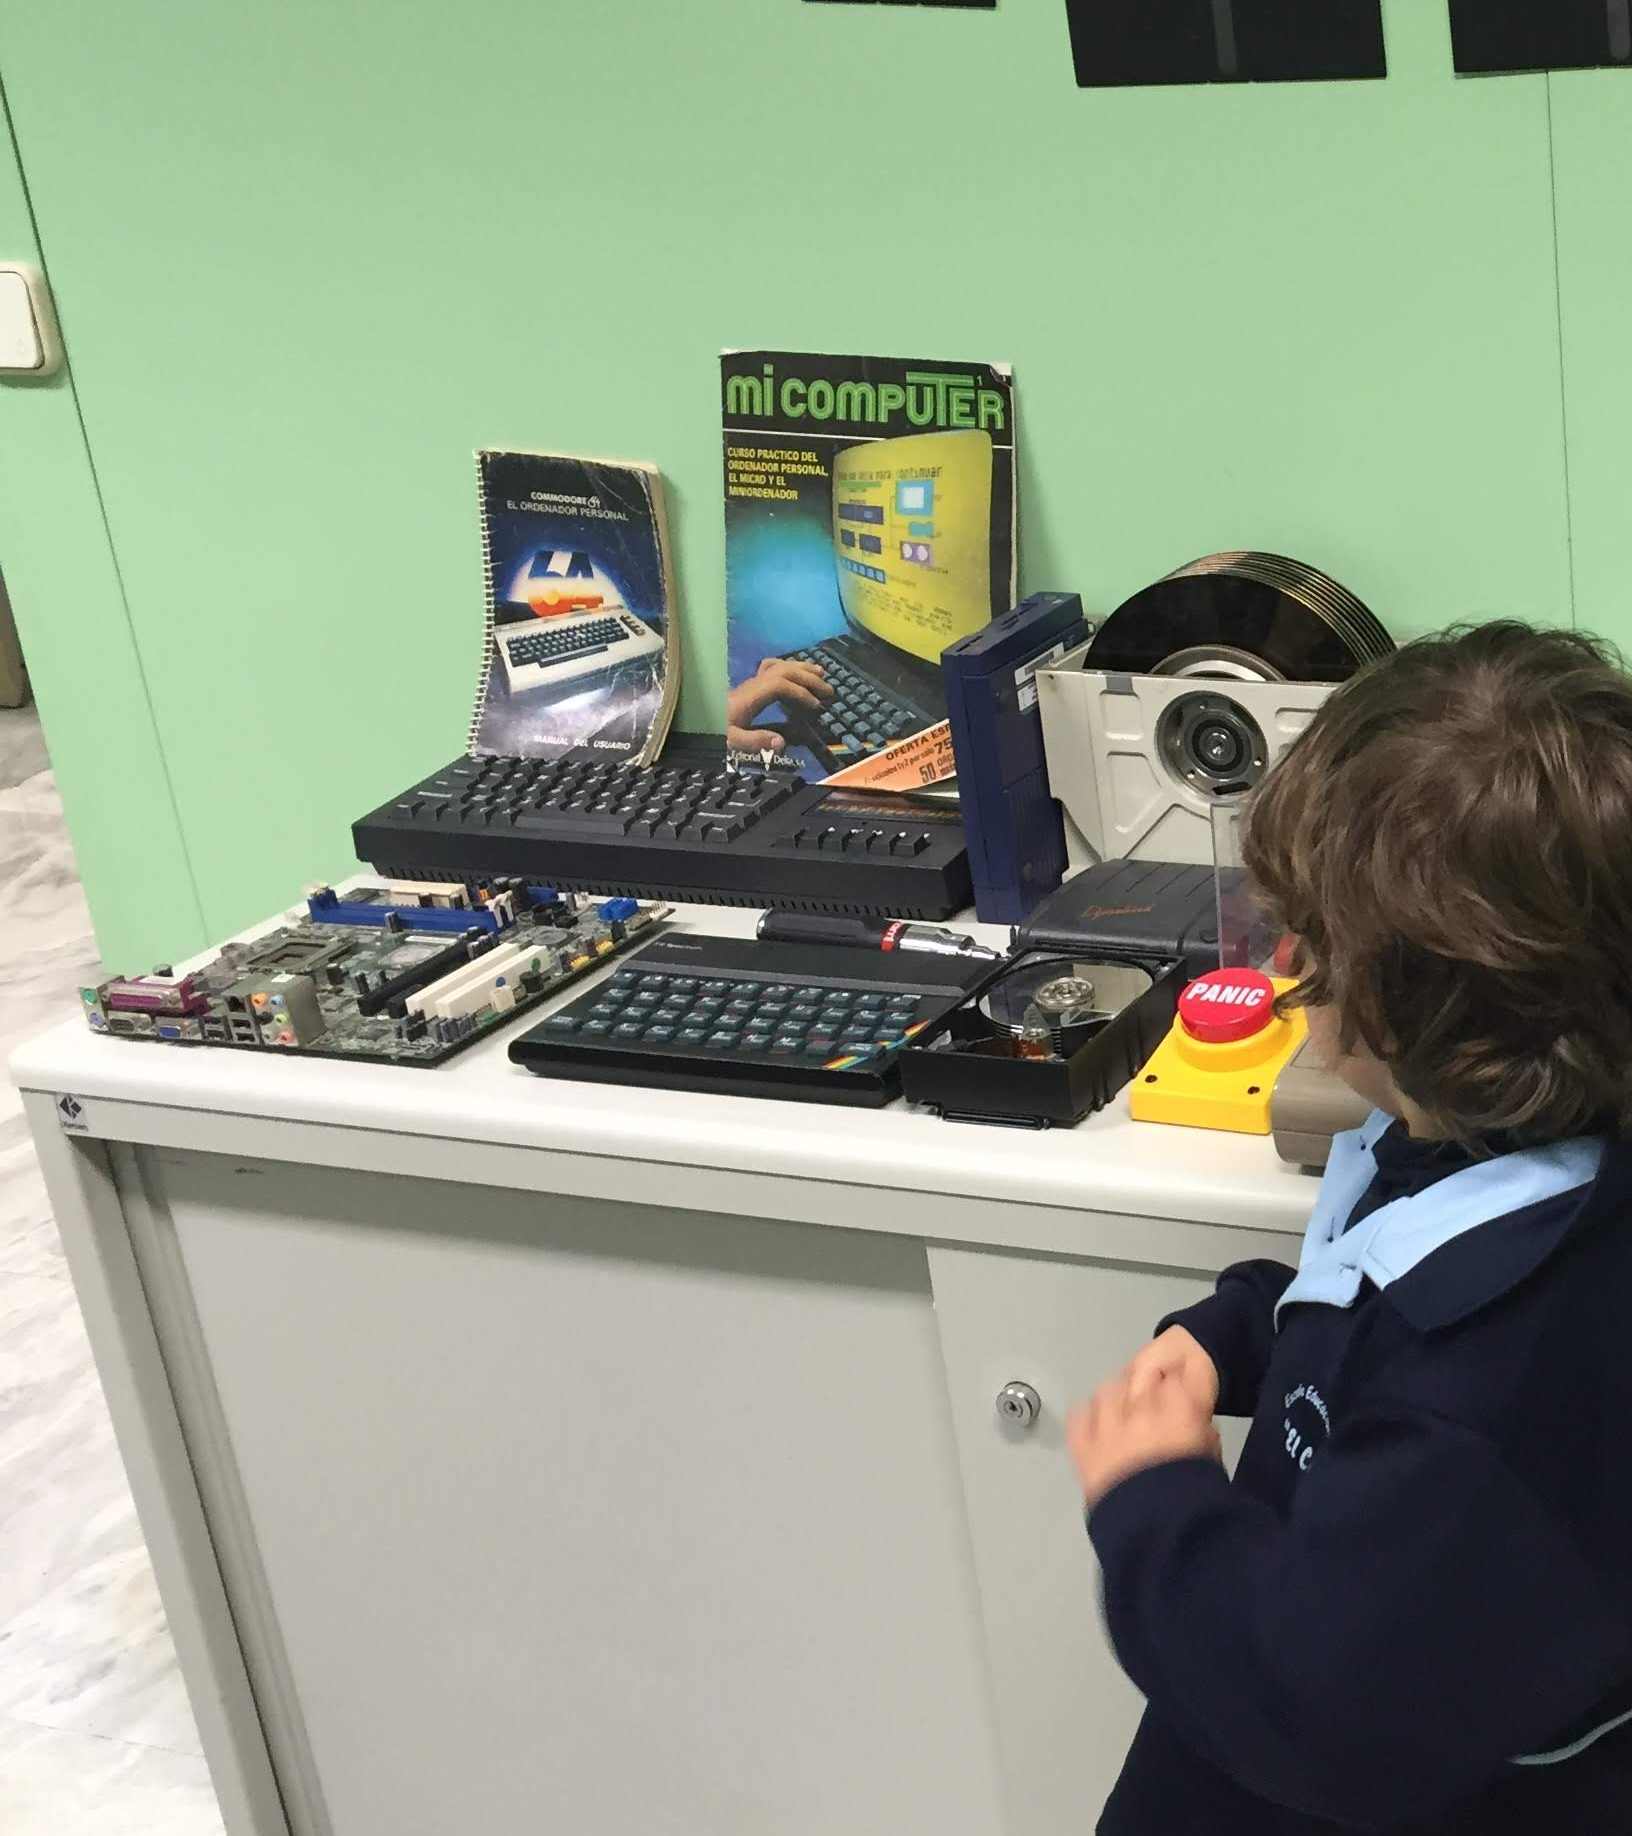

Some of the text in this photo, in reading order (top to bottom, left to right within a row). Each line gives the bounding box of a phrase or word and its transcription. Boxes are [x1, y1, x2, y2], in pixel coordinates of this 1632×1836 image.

[780, 371, 1005, 429] COMPUTER
[727, 447, 756, 459] CURSO
[801, 452, 819, 463] DEL
[727, 460, 780, 473] ORDENADOR
[728, 473, 787, 486] EL MICRO Y EL
[728, 486, 799, 500] MINIORDENADOR
[506, 500, 630, 521] EL ORDENADOR PERSONAL
[533, 735, 632, 751] MANUAL DEL USUARIO
[886, 736, 929, 761] OFERTA
[1185, 982, 1266, 1007] PANIC
